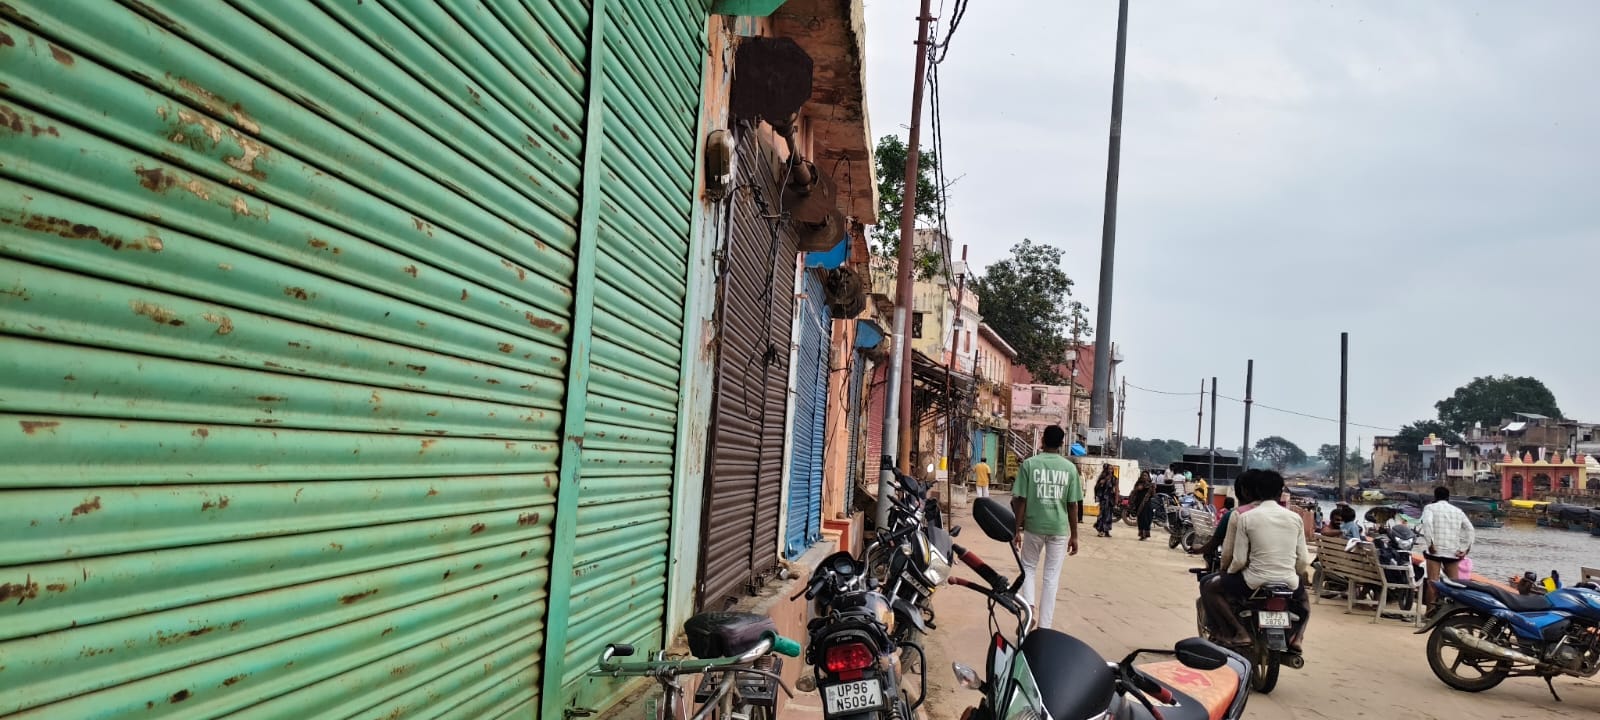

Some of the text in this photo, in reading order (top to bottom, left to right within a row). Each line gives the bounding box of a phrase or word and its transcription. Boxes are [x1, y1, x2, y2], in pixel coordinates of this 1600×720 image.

[1033, 468, 1069, 485] CALVIN
[1037, 483, 1065, 499] KLEIN
[837, 681, 868, 697] UP96
[836, 693, 876, 710] N5094
